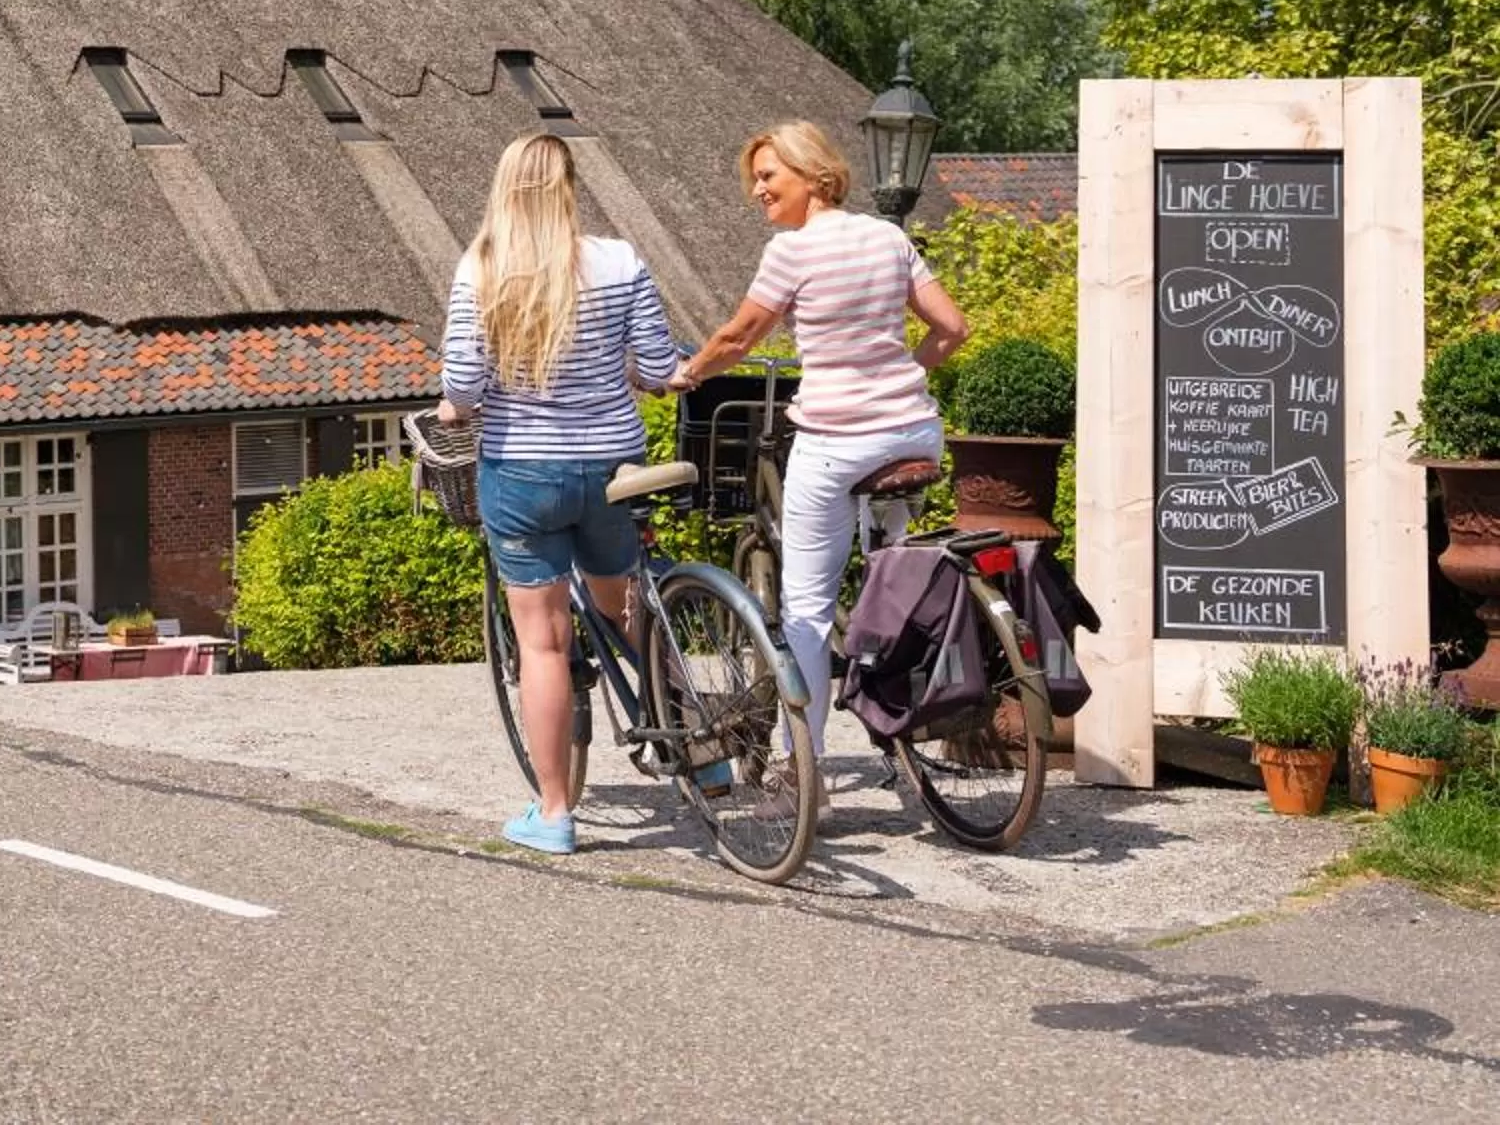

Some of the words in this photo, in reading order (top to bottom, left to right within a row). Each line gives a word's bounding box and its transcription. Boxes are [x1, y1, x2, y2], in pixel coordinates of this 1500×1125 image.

[1223, 161, 1262, 180] DE
[1166, 173, 1236, 211] LINGE
[1250, 183, 1328, 212] HOEVE
[1211, 228, 1282, 258] OPEN
[1168, 282, 1231, 313] LUNCH
[1268, 294, 1333, 338] DINER
[1209, 328, 1284, 353] ONTBIJT
[1169, 380, 1263, 400] UITGEBREIDE
[1289, 371, 1338, 405] HIGH
[1169, 400, 1218, 415] KOFFIE
[1227, 403, 1273, 418] KAART
[1288, 408, 1328, 435] TEA
[1183, 420, 1251, 440] HEERLIJKE
[1187, 458, 1250, 473] TAARTEN
[1170, 488, 1227, 506] STREEK
[1267, 487, 1323, 517] BITES
[1161, 511, 1249, 530] PRODUCTEN
[1169, 576, 1199, 593] DE
[1212, 576, 1313, 596] GEZONDE
[1200, 600, 1290, 625] KEUKEN
